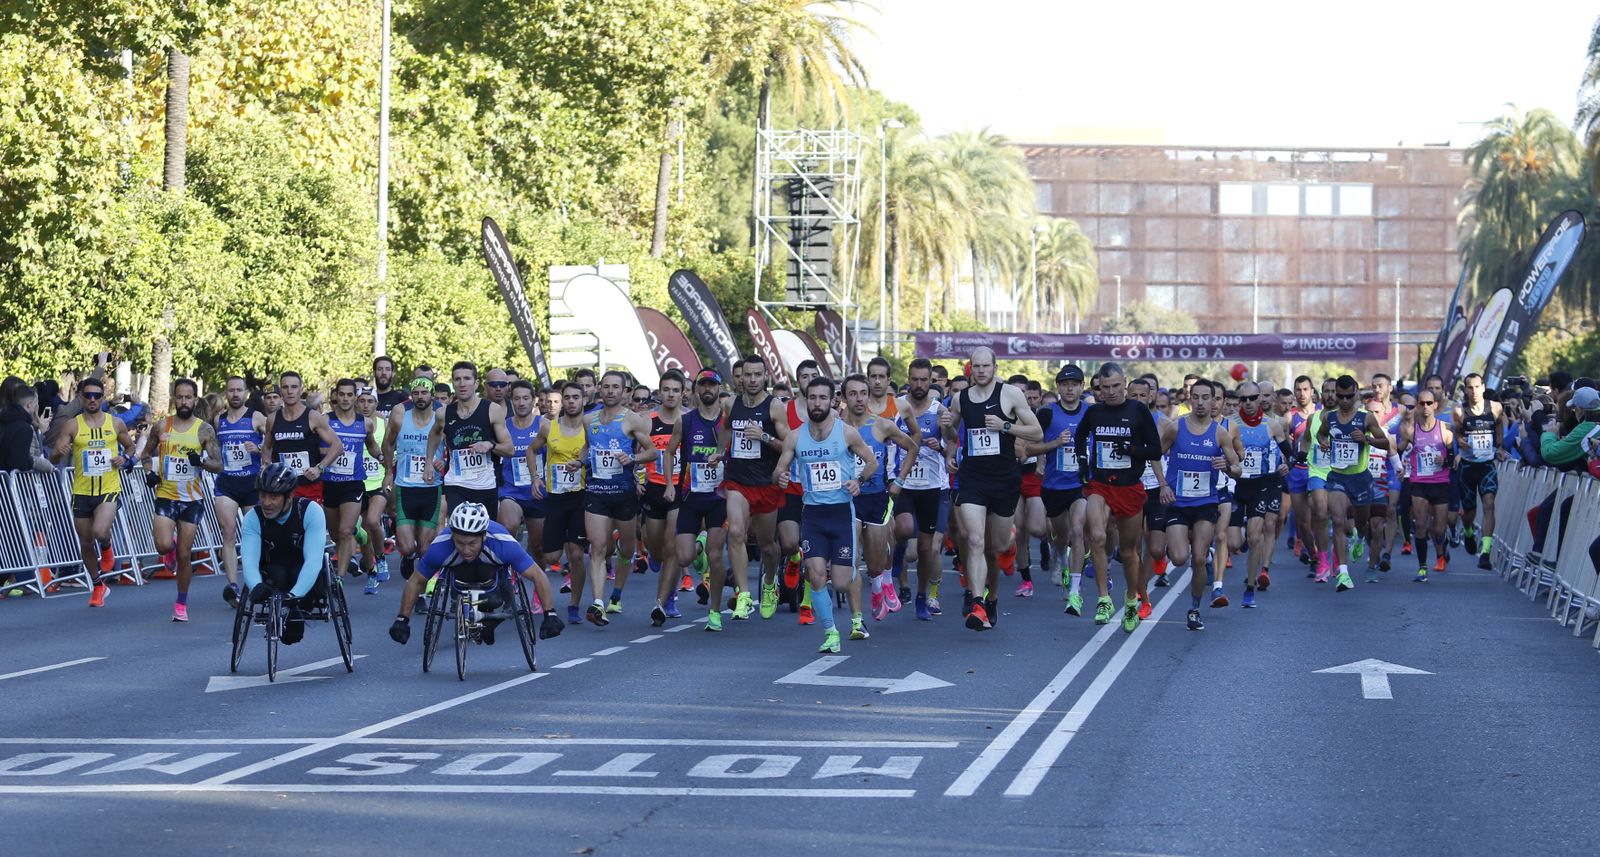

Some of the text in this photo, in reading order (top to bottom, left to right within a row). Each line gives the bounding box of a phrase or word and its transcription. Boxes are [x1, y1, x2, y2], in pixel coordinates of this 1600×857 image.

[1086, 335, 1101, 345] 35
[1103, 335, 1145, 345] MEDIA
[1211, 335, 1243, 345] 2019
[1299, 337, 1357, 350] IMDECO
[1110, 345, 1225, 359] CÓRDOBA
[1095, 426, 1131, 435] GRANADA
[275, 432, 305, 440] GRANADA
[403, 433, 428, 442] nerja
[740, 439, 752, 451] 50
[978, 436, 991, 447] 19
[1477, 440, 1491, 449] 113
[232, 451, 244, 461] 39
[801, 447, 830, 458] nerja
[1338, 449, 1354, 459] 157
[94, 456, 105, 466] 94
[290, 459, 302, 469] 48
[336, 457, 348, 467] 40
[464, 455, 483, 467] 100
[602, 457, 614, 468] 67
[1243, 458, 1255, 468] 63
[175, 464, 188, 474] 96
[562, 472, 575, 483] 78
[704, 469, 718, 480] 98
[815, 469, 836, 482] 149
[1193, 479, 1200, 490] 2
[305, 752, 924, 780] MOTOS
